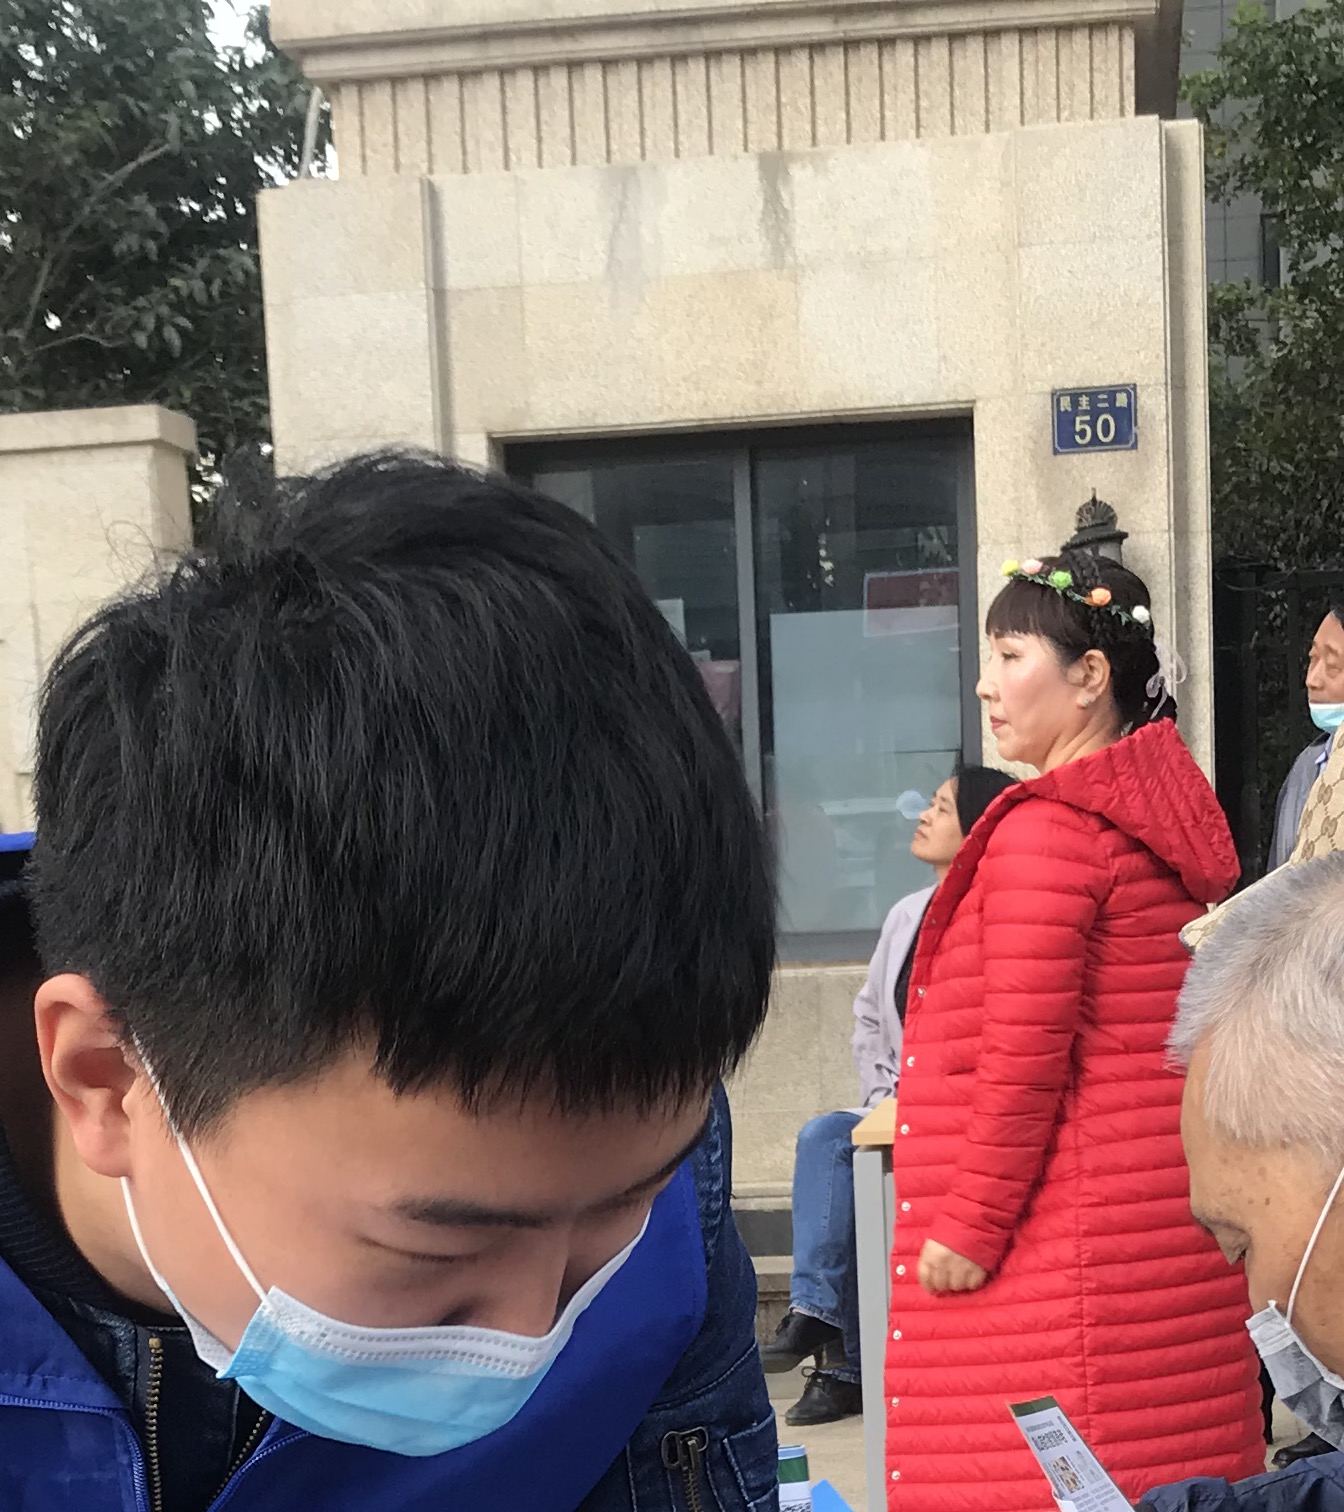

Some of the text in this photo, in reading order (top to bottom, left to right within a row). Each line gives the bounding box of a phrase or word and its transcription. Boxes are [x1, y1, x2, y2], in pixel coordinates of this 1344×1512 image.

[1059, 392, 1128, 412] 民主二路
[1074, 414, 1116, 445] 50
